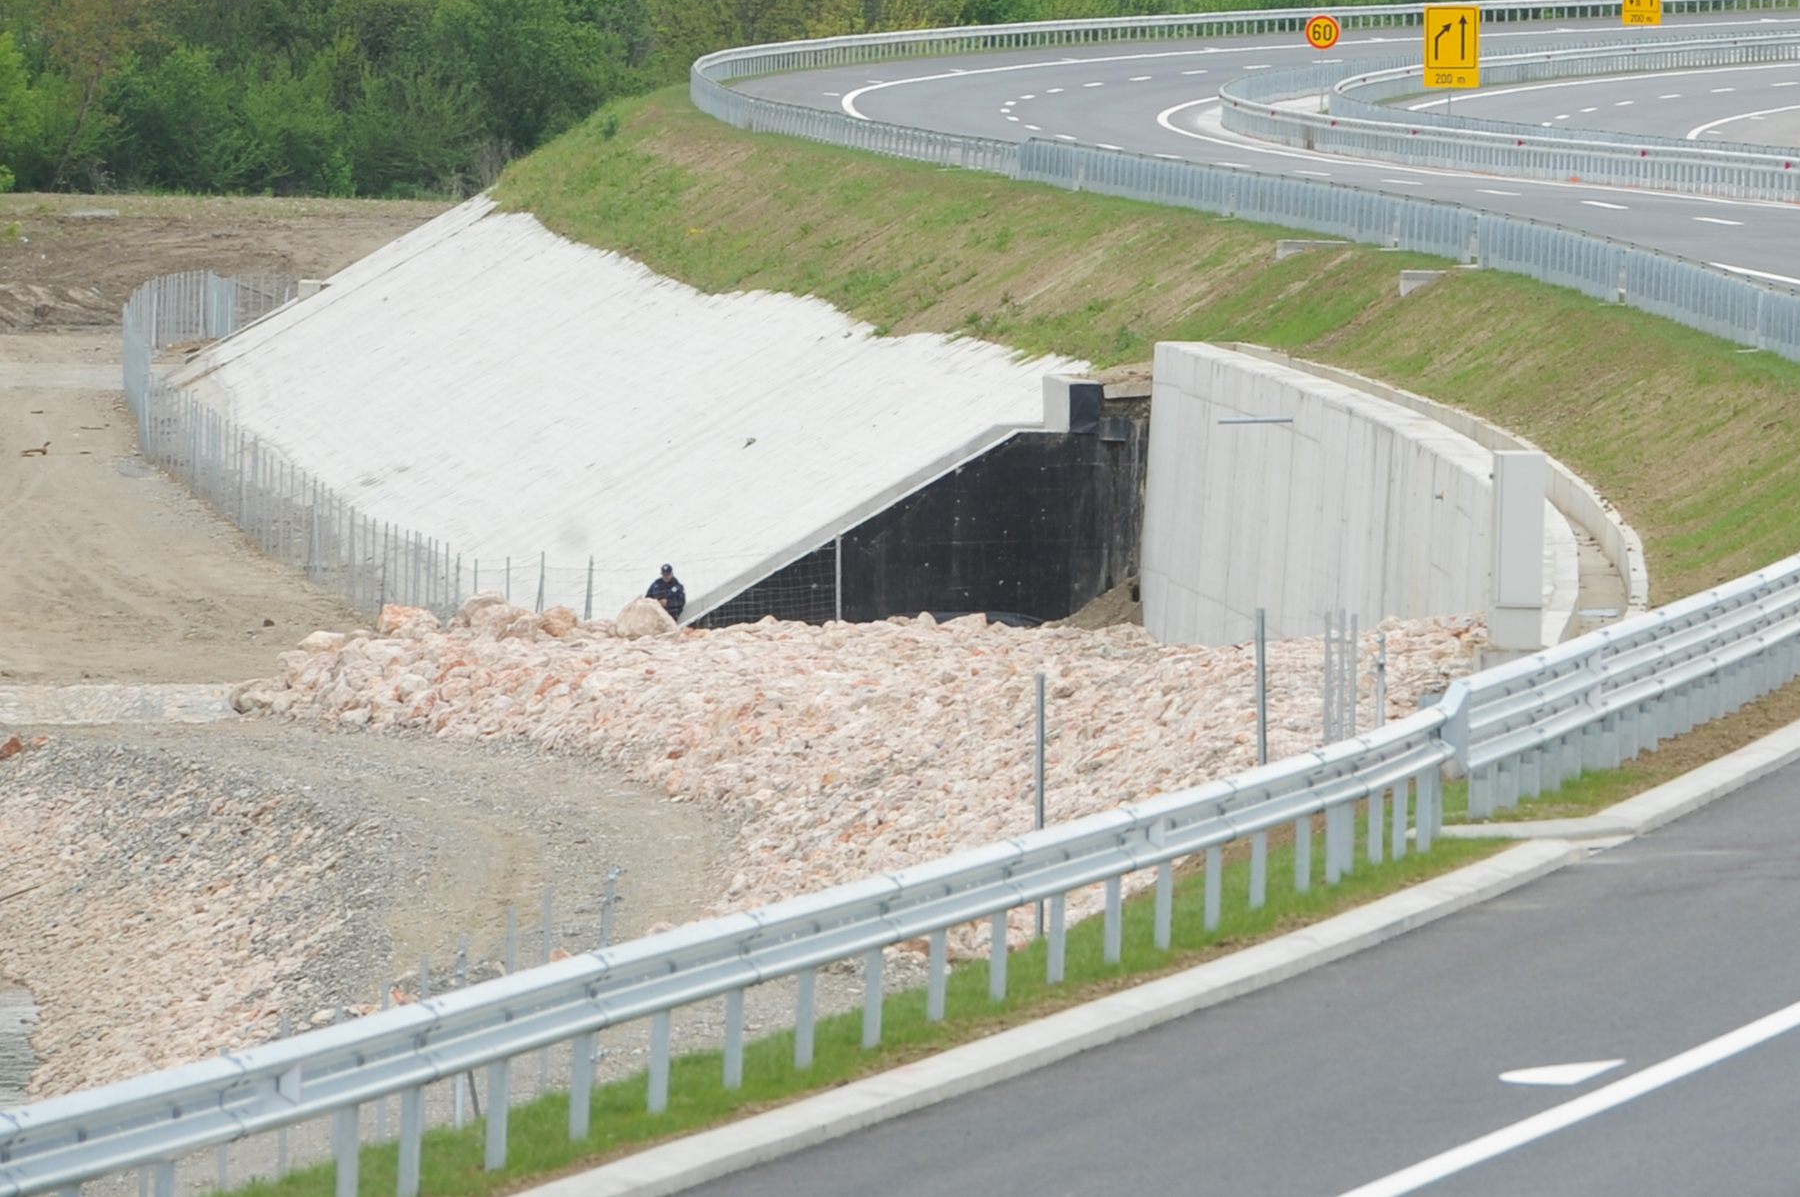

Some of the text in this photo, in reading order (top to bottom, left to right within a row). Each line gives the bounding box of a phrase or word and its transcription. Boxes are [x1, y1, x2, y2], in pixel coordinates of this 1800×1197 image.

[1630, 13, 1645, 23] 200
[1312, 24, 1332, 41] 60
[1435, 73, 1465, 84] 200 m
